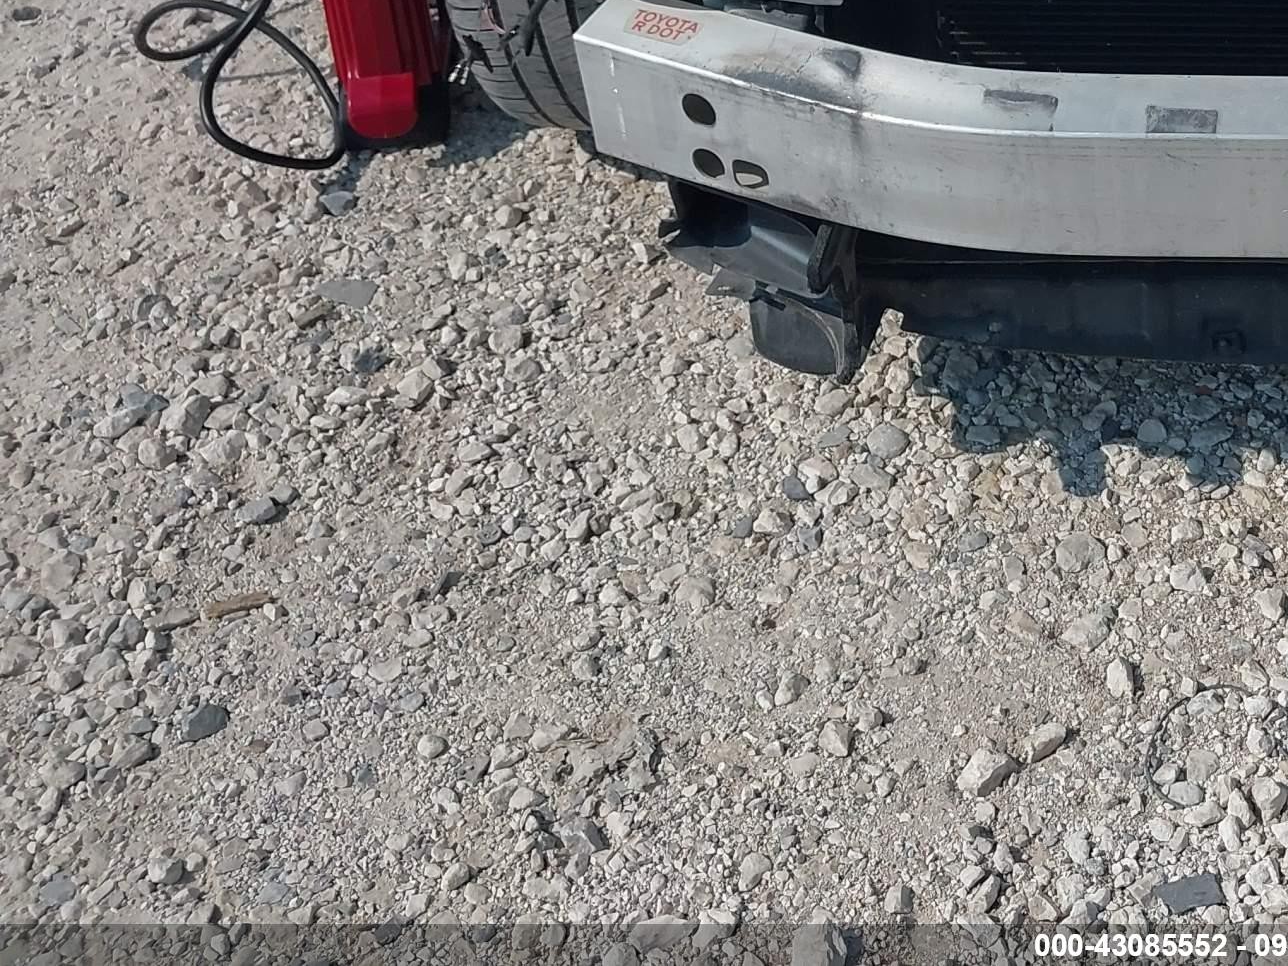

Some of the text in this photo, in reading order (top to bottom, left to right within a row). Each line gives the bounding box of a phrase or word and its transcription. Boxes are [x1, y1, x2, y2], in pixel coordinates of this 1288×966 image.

[632, 21, 685, 40] R DOT
[634, 9, 698, 33] TOYOTA
